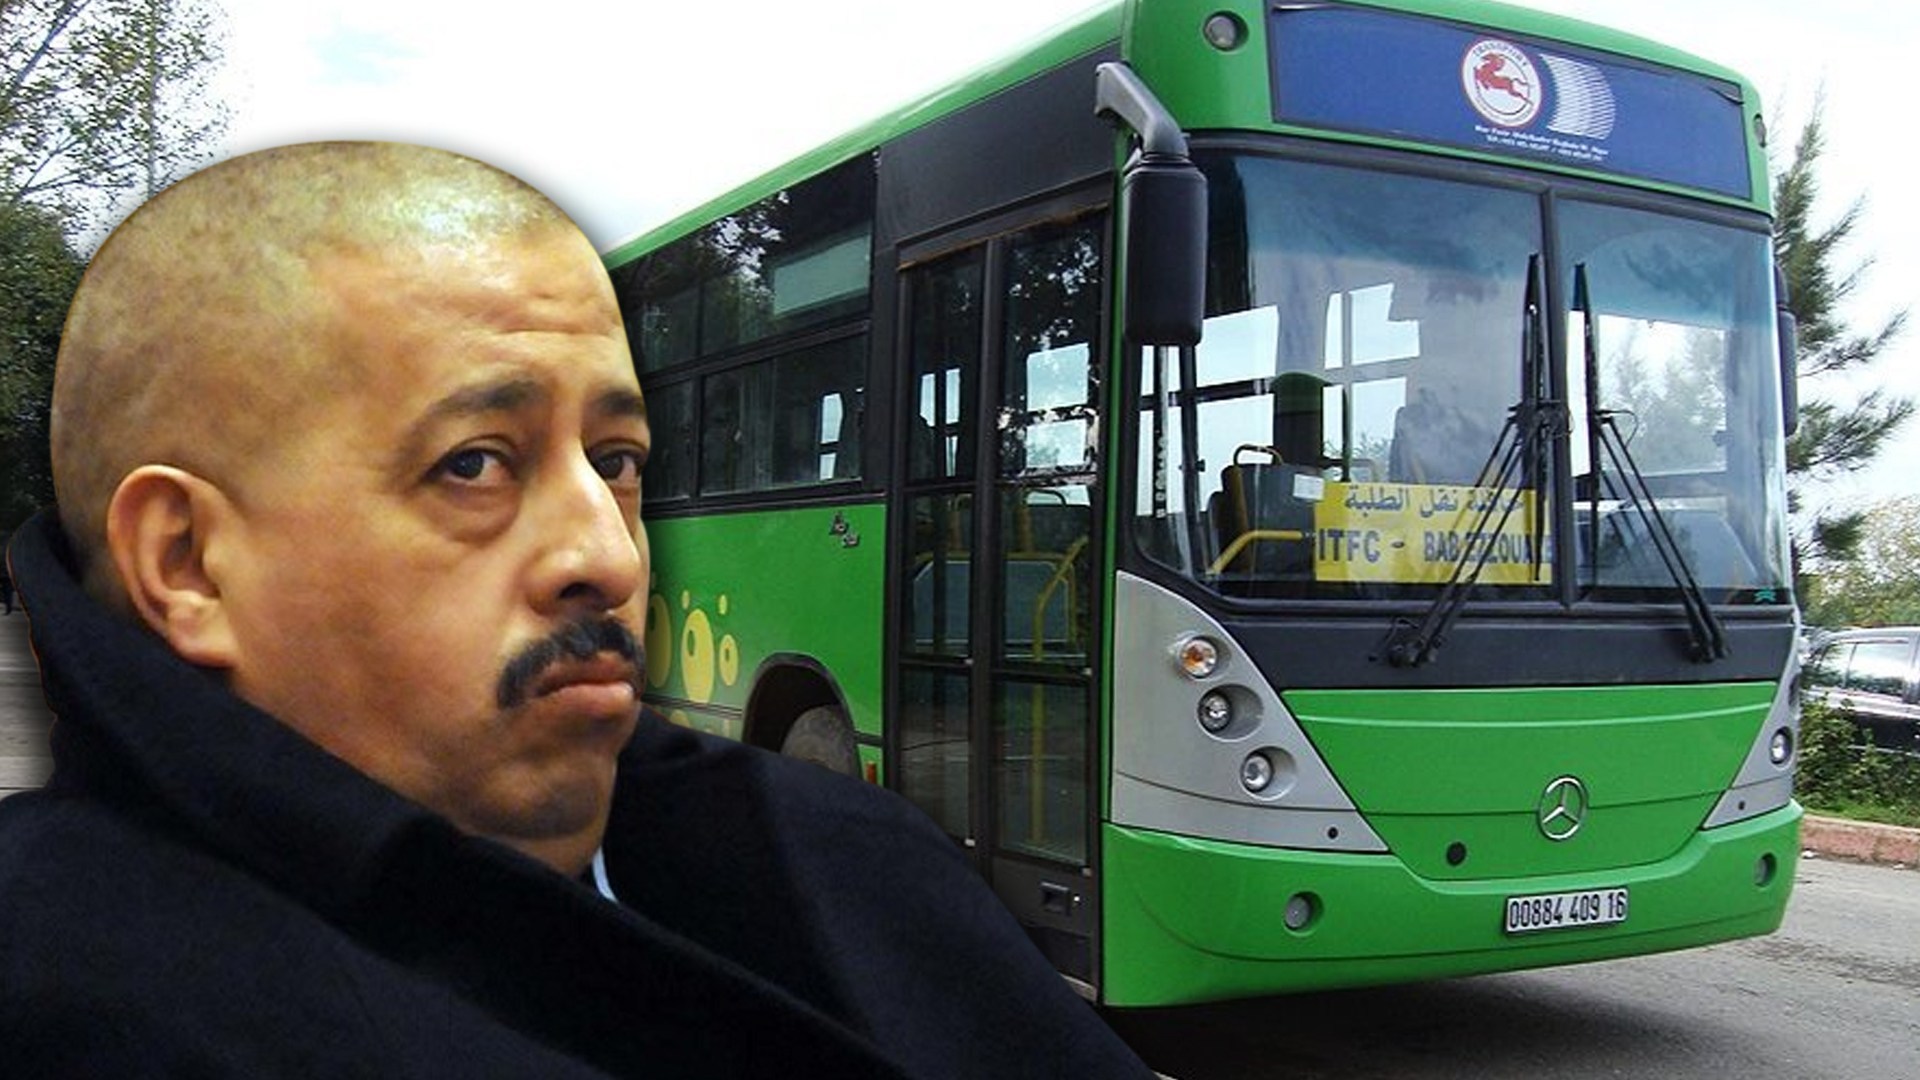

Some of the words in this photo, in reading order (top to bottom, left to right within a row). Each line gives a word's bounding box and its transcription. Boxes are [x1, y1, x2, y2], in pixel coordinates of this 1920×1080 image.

[1345, 485, 1410, 518] الطلبة
[1420, 486, 1458, 518] نقل
[1319, 528, 1381, 563] ITFC
[1424, 530, 1459, 562] BAB
[1509, 897, 1563, 929] 00884
[1569, 894, 1600, 922] 409
[1607, 891, 1627, 919] 16
